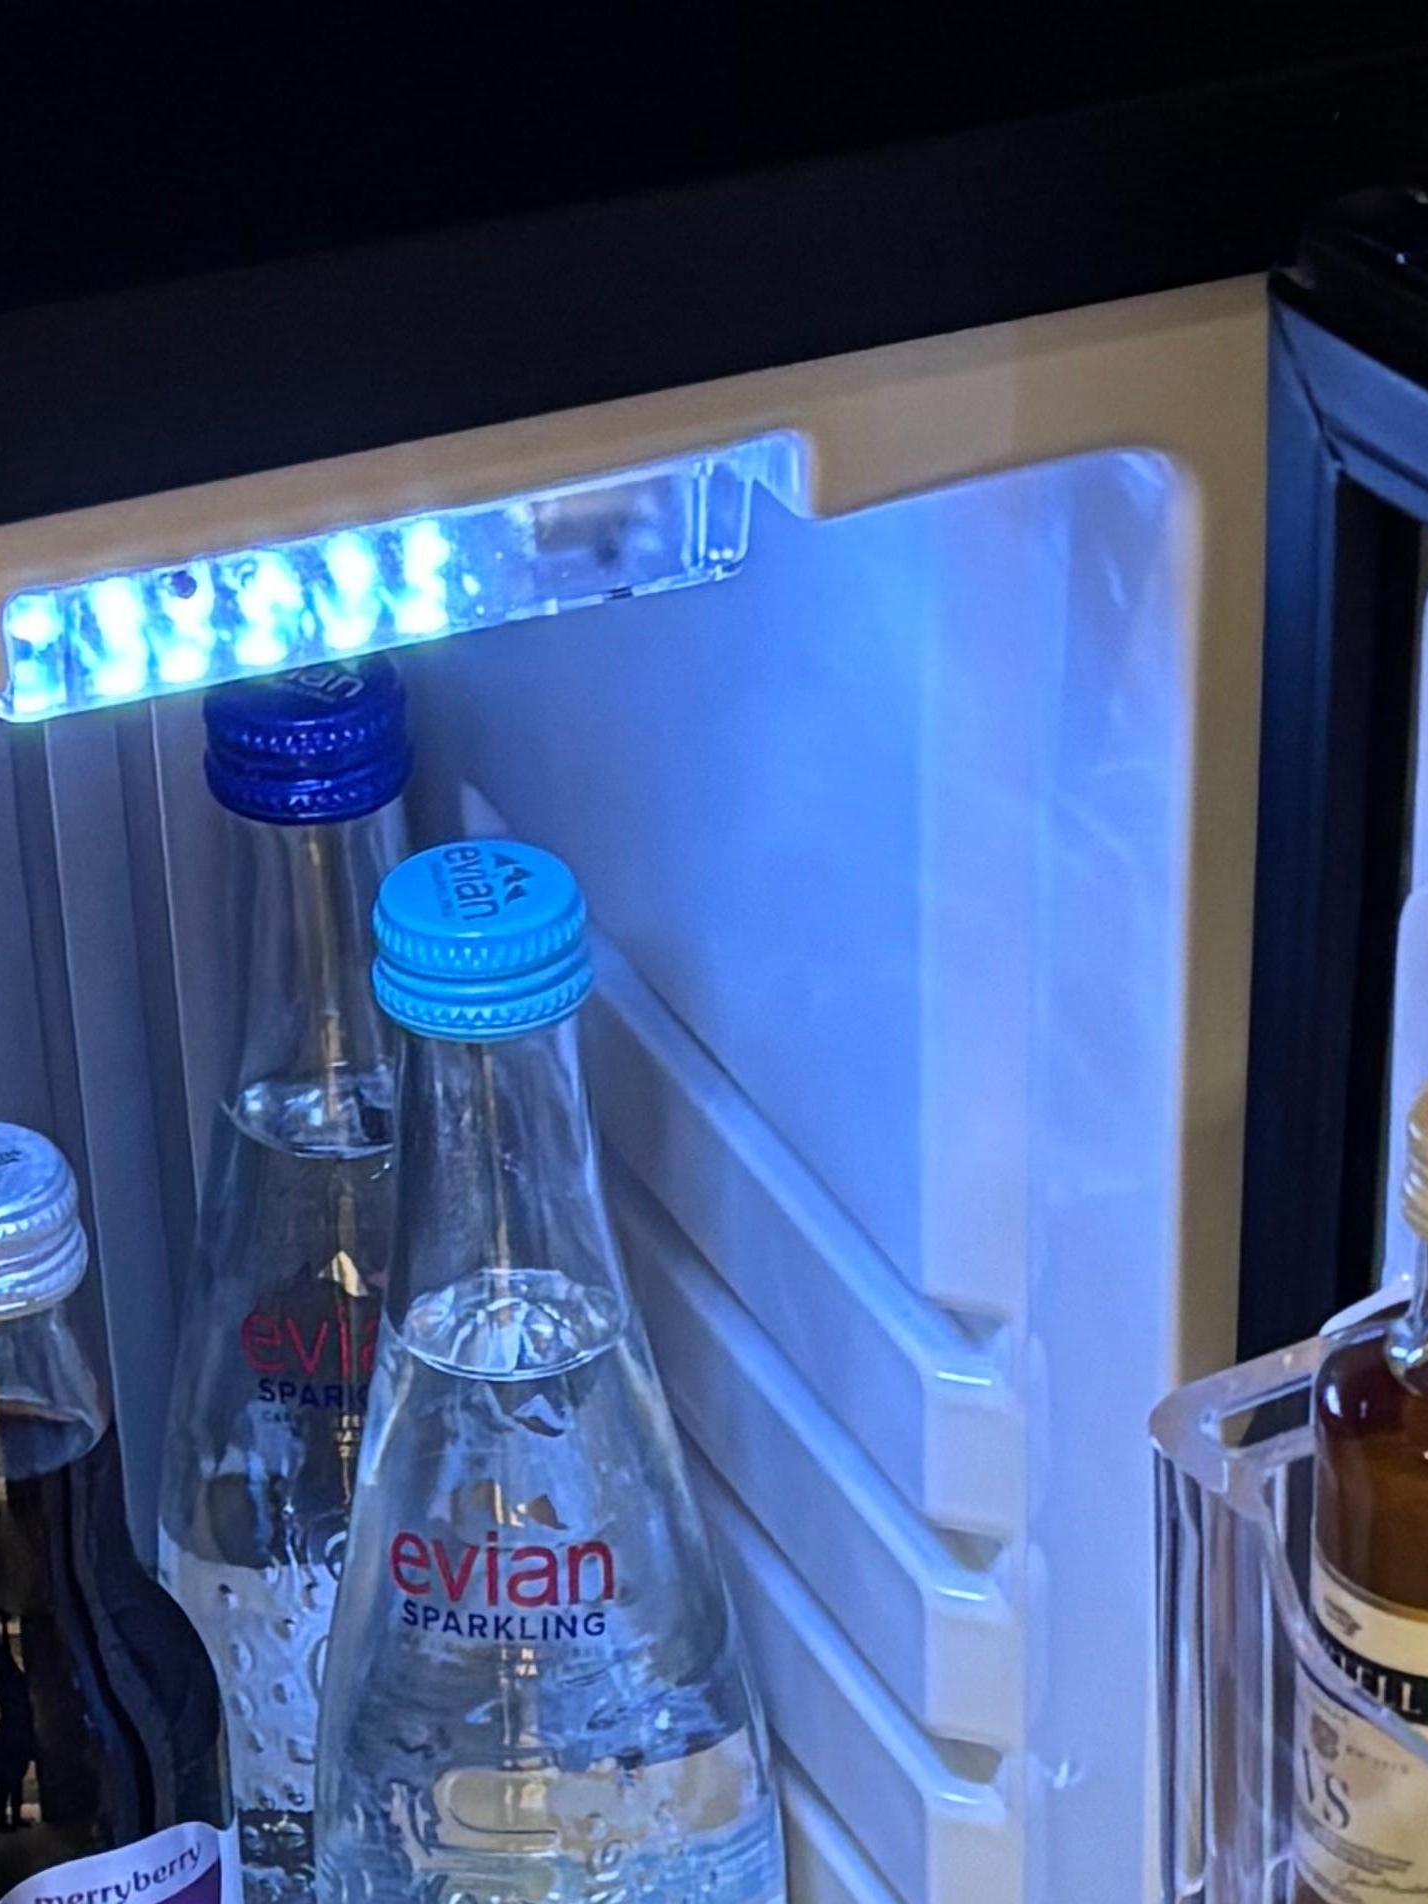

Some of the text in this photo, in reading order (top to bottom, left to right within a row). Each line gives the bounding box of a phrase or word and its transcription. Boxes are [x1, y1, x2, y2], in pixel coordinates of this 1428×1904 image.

[443, 846, 501, 920] evian
[389, 1530, 615, 1608] evian
[401, 1599, 607, 1642] SPARKLING
